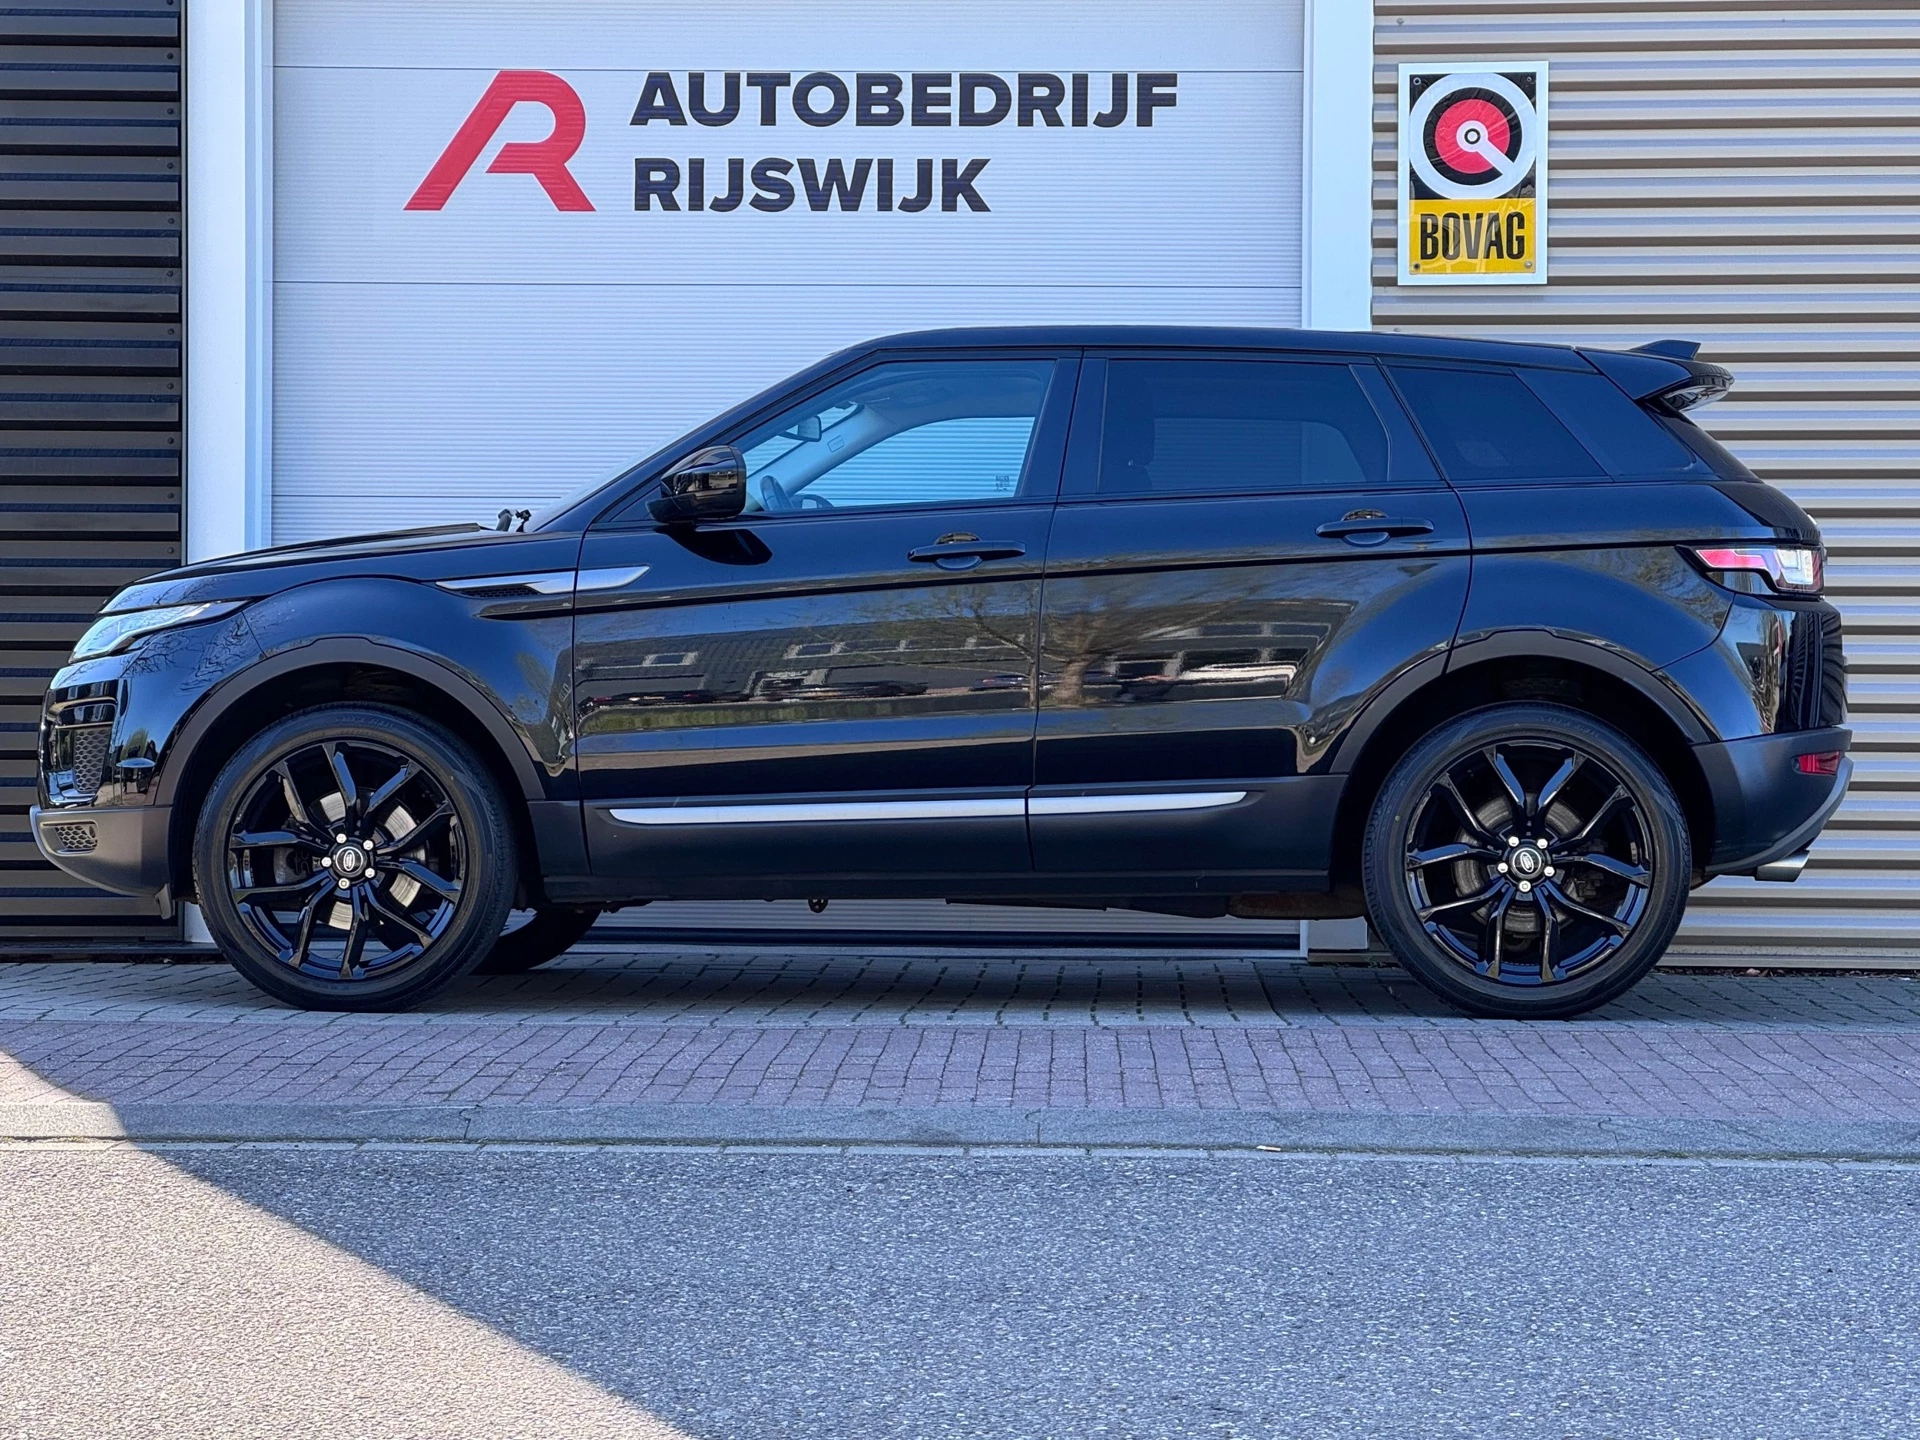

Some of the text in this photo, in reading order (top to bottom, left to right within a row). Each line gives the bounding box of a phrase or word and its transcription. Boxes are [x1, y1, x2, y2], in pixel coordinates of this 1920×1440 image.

[630, 72, 1178, 128] AUTOBEDRIJF
[634, 158, 991, 212] RIJSWIJK
[1420, 212, 1525, 260] BOVAG
